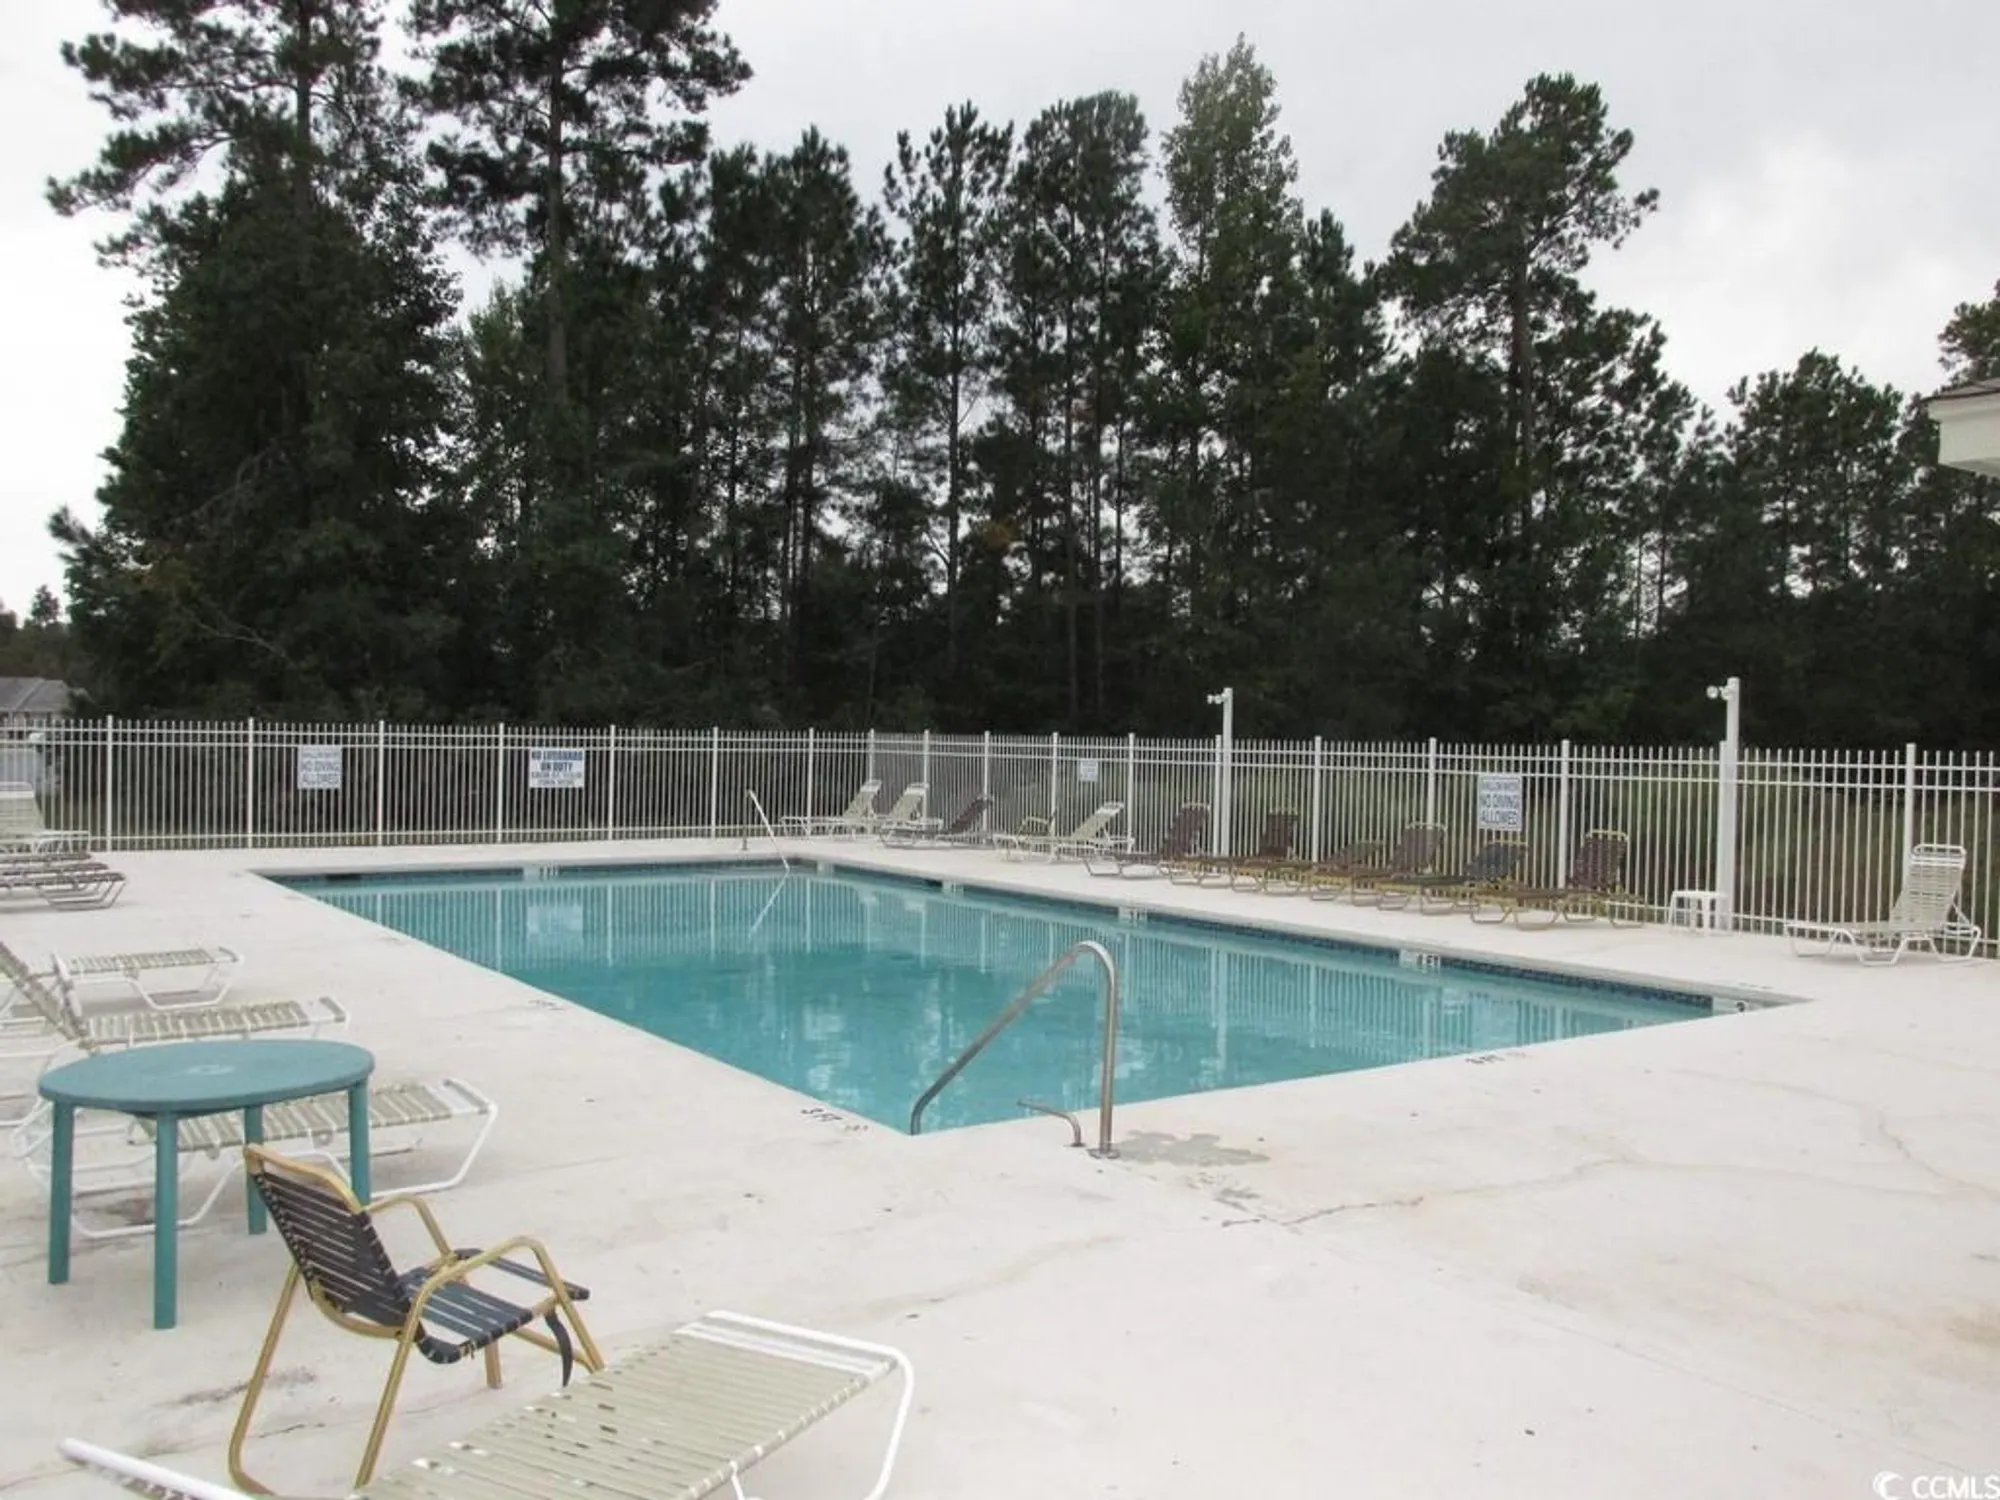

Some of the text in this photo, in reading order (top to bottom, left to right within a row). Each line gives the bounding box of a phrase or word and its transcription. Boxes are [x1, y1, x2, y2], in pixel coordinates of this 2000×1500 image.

[532, 750, 542, 760] NO
[553, 762, 573, 772] DUTY
[1480, 794, 1520, 809] NO DIVING
[1481, 810, 1519, 825] ALLOWED
